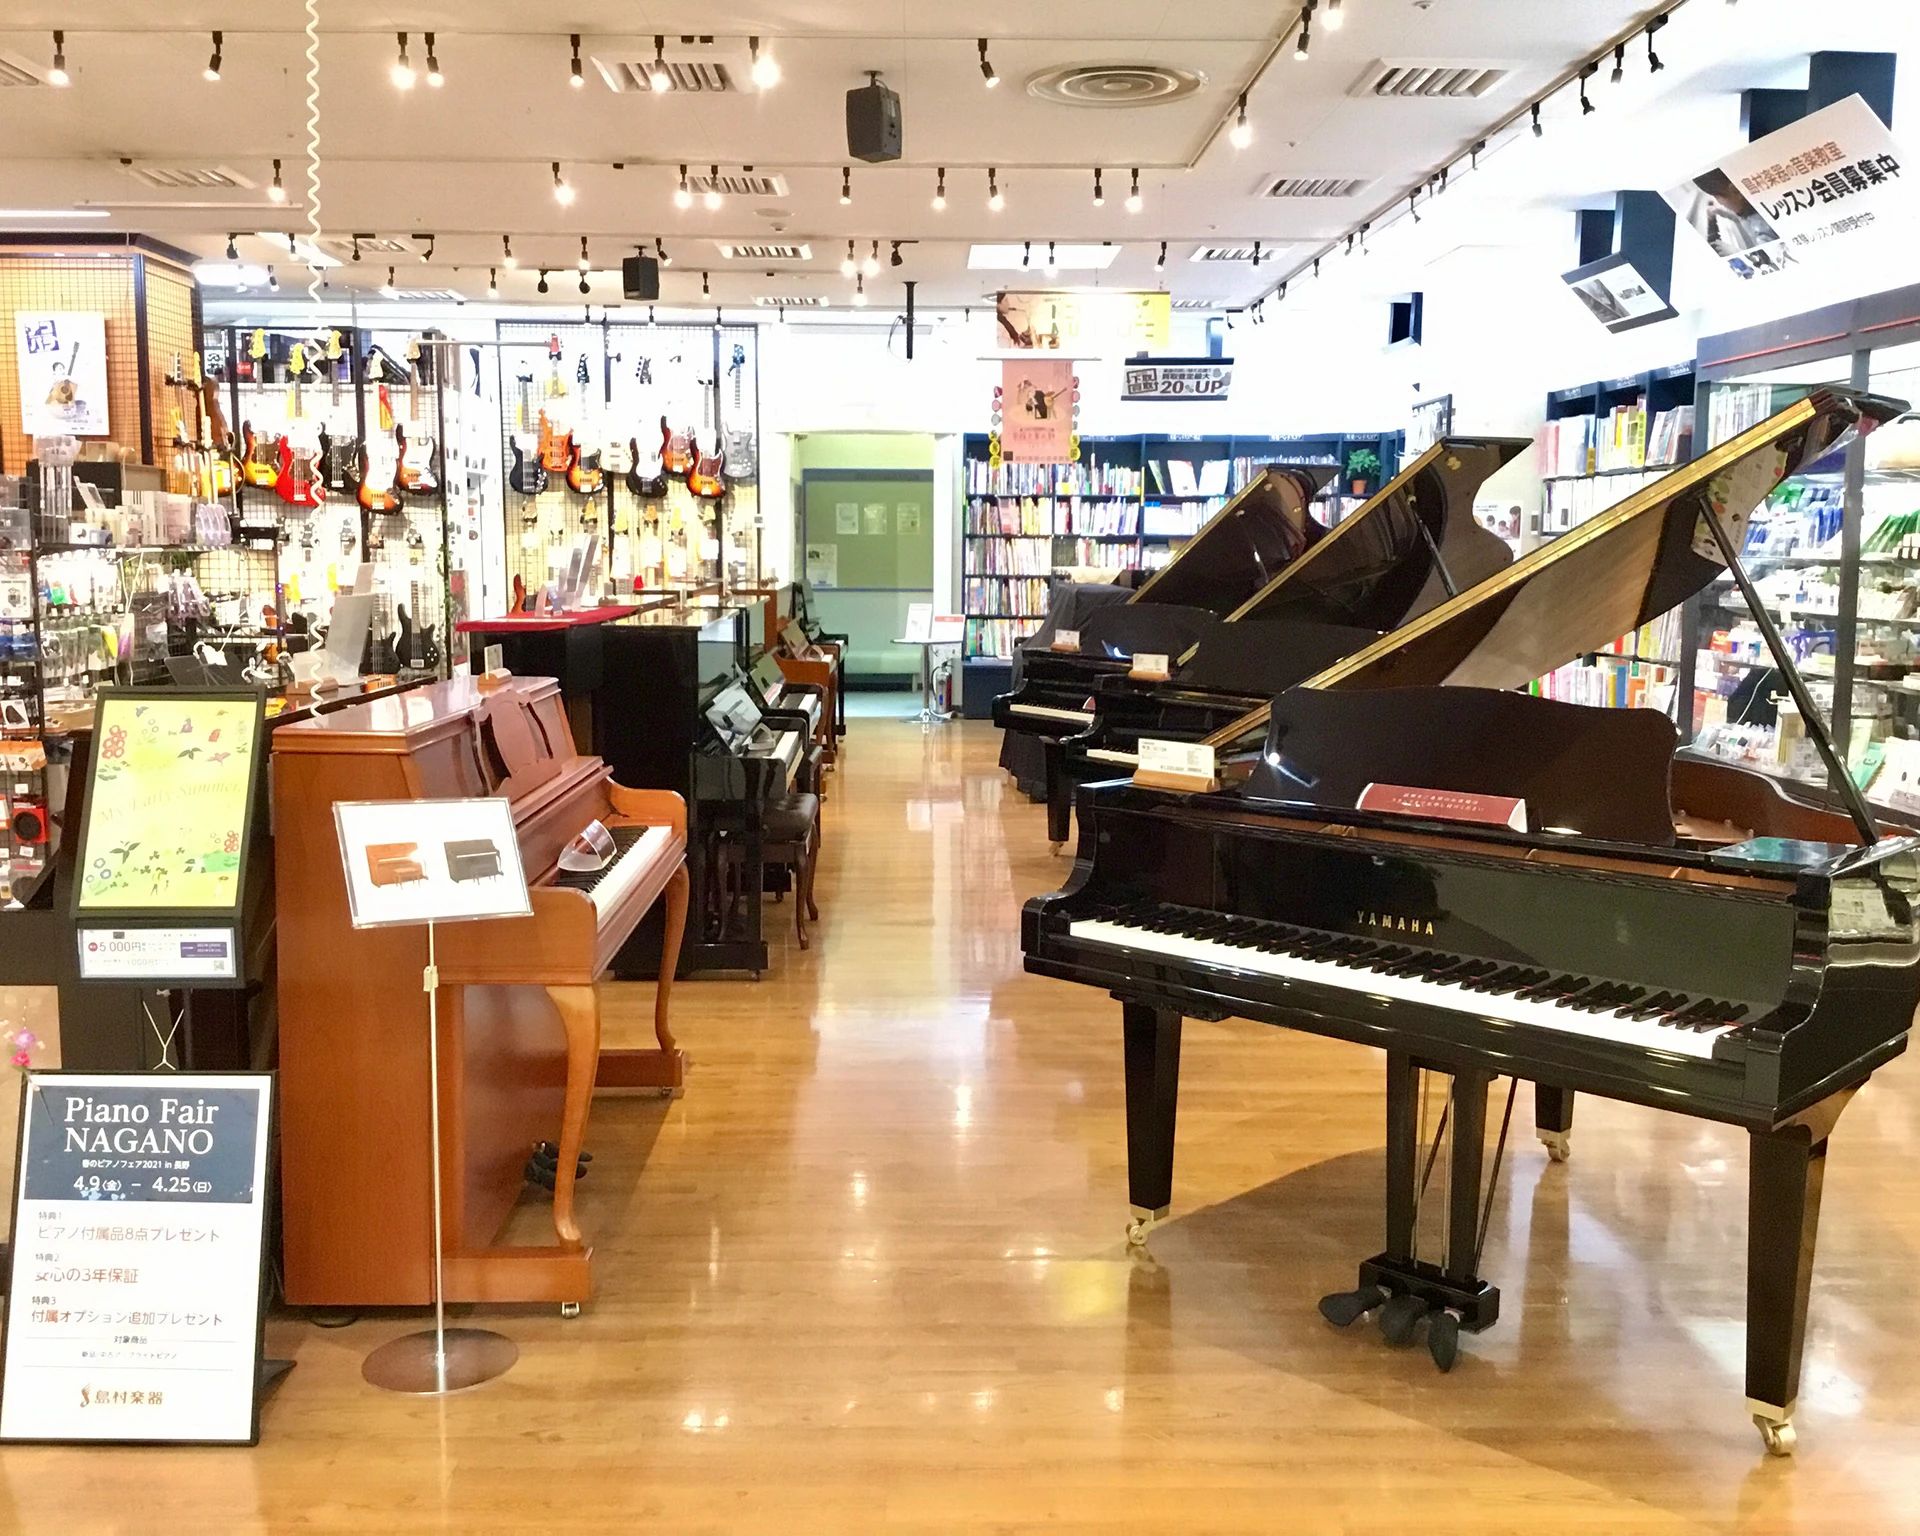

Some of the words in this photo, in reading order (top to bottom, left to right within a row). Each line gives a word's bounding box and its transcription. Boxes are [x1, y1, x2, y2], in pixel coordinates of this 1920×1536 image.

[1741, 141, 1846, 195] 島村楽器の音楽教室
[1760, 153, 1900, 221] レッスン会員募集中
[1357, 910, 1434, 935] YAMAHA
[64, 1097, 149, 1123] Piano
[159, 1098, 219, 1124] Fair
[64, 1127, 214, 1155] NAGANO
[82, 1159, 162, 1169] 春のピアノフェア2021
[164, 1161, 172, 1169] in
[38, 1226, 220, 1243] ピアノ付属品8点プレゼント
[31, 1309, 222, 1326] 付属オプション追加プレゼント
